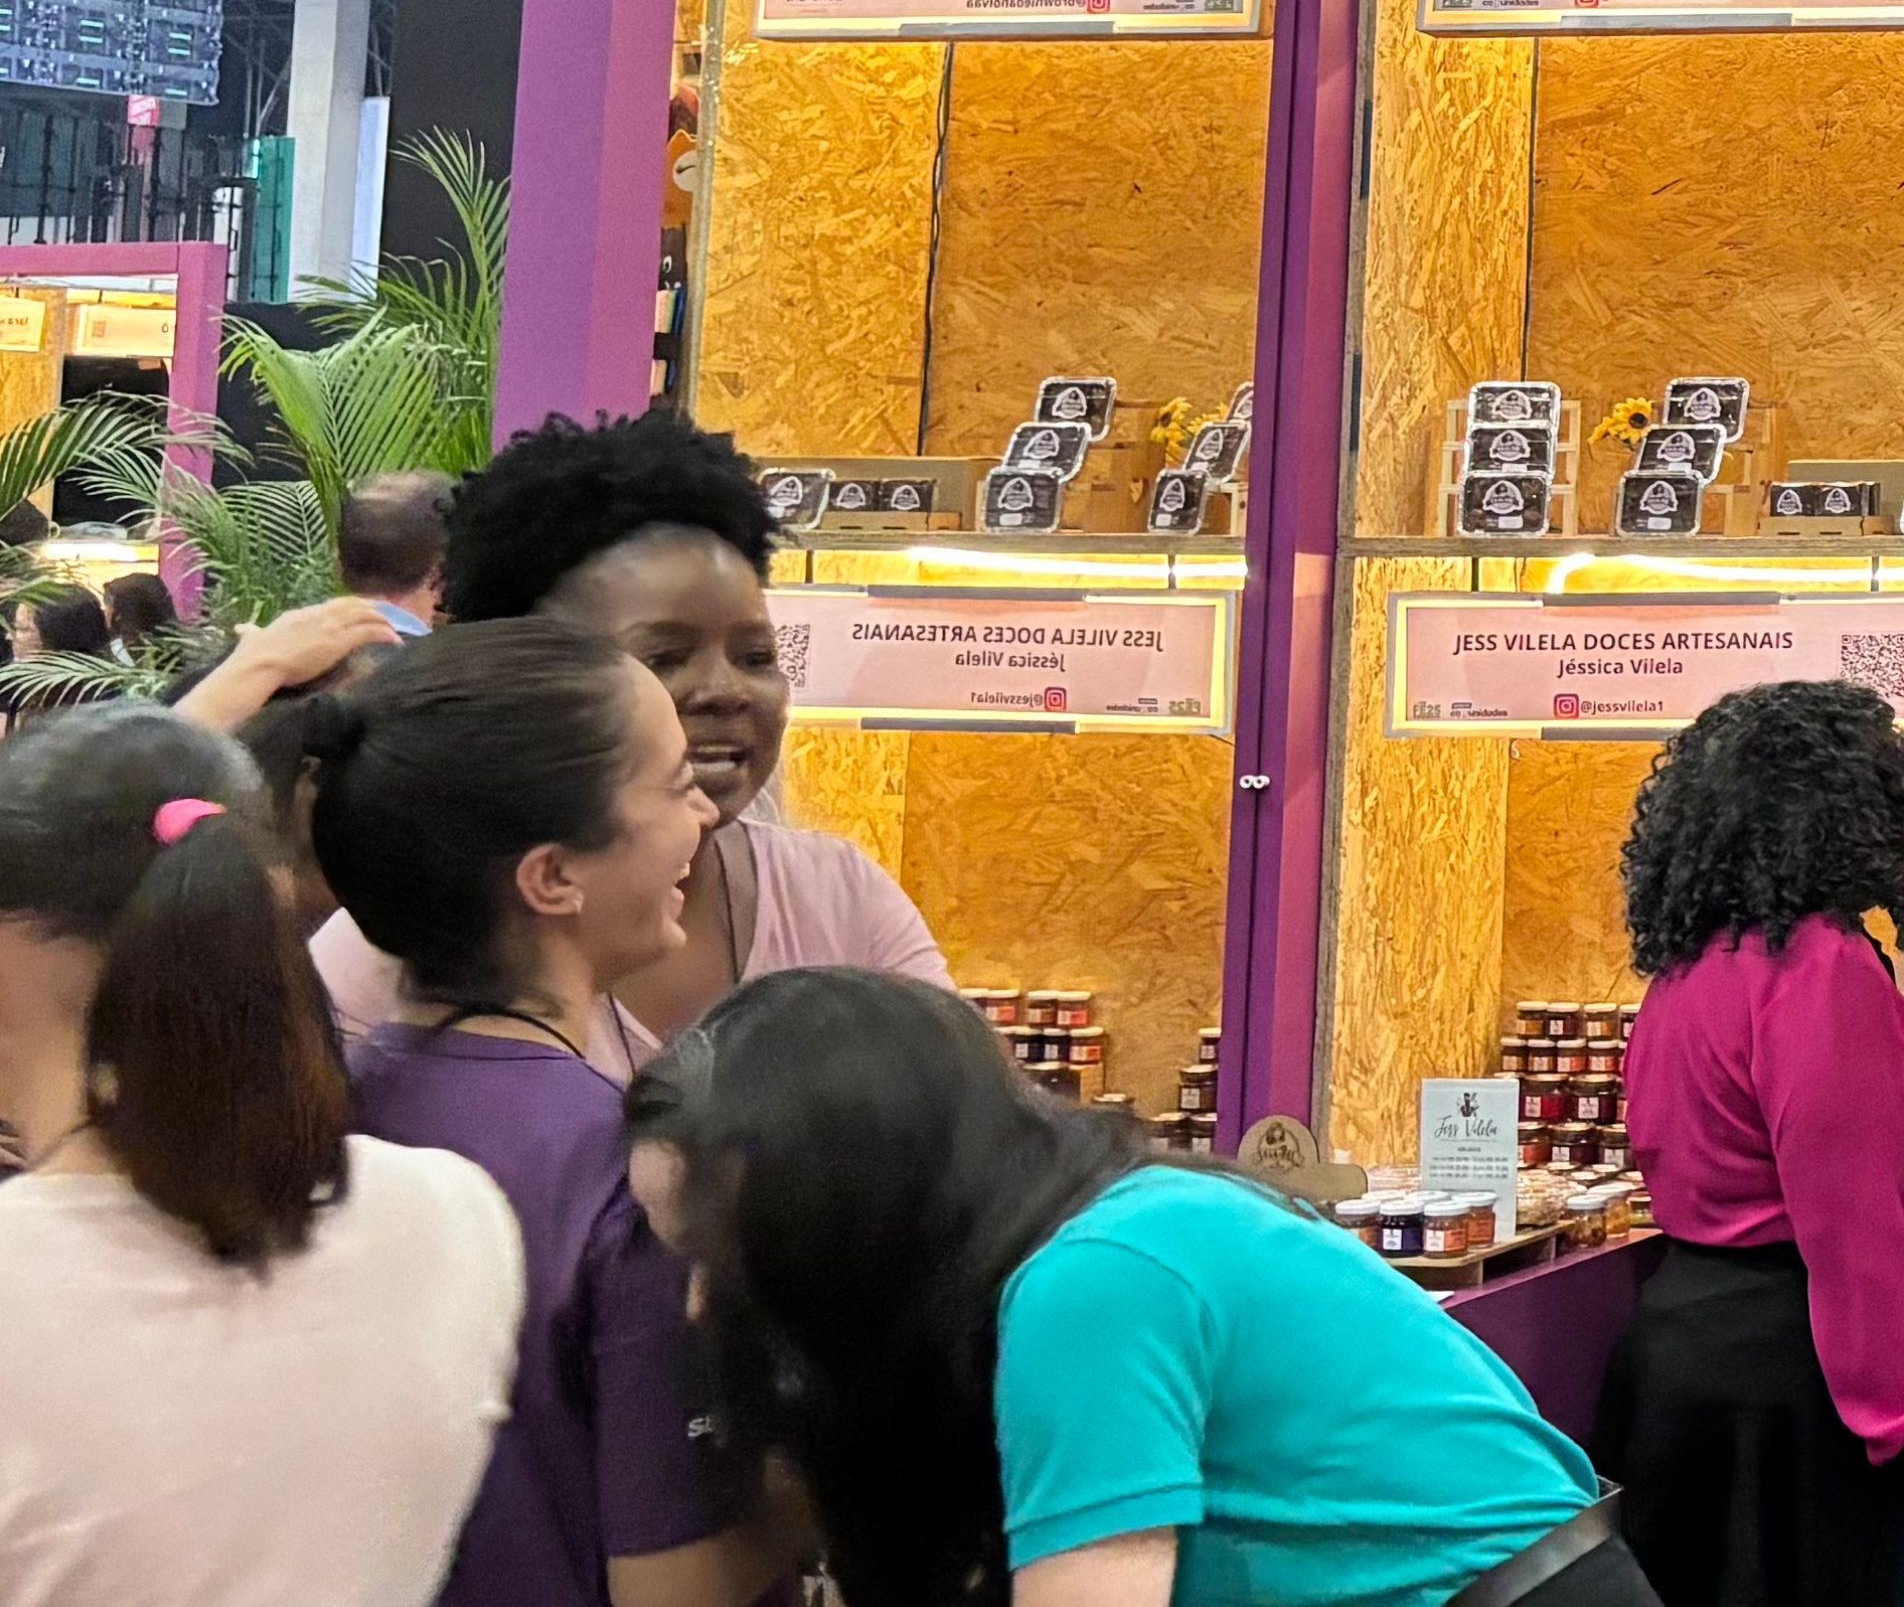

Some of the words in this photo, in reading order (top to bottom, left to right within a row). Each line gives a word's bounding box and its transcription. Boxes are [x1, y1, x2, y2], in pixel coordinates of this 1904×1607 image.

[1452, 634, 1498, 656] JESS
[1503, 633, 1577, 651] VILELA
[1584, 632, 1656, 651] DOCES
[1661, 631, 1793, 650] ARTESANAIS
[1556, 658, 1624, 679] Jéssica
[1629, 657, 1683, 675] Vilela
